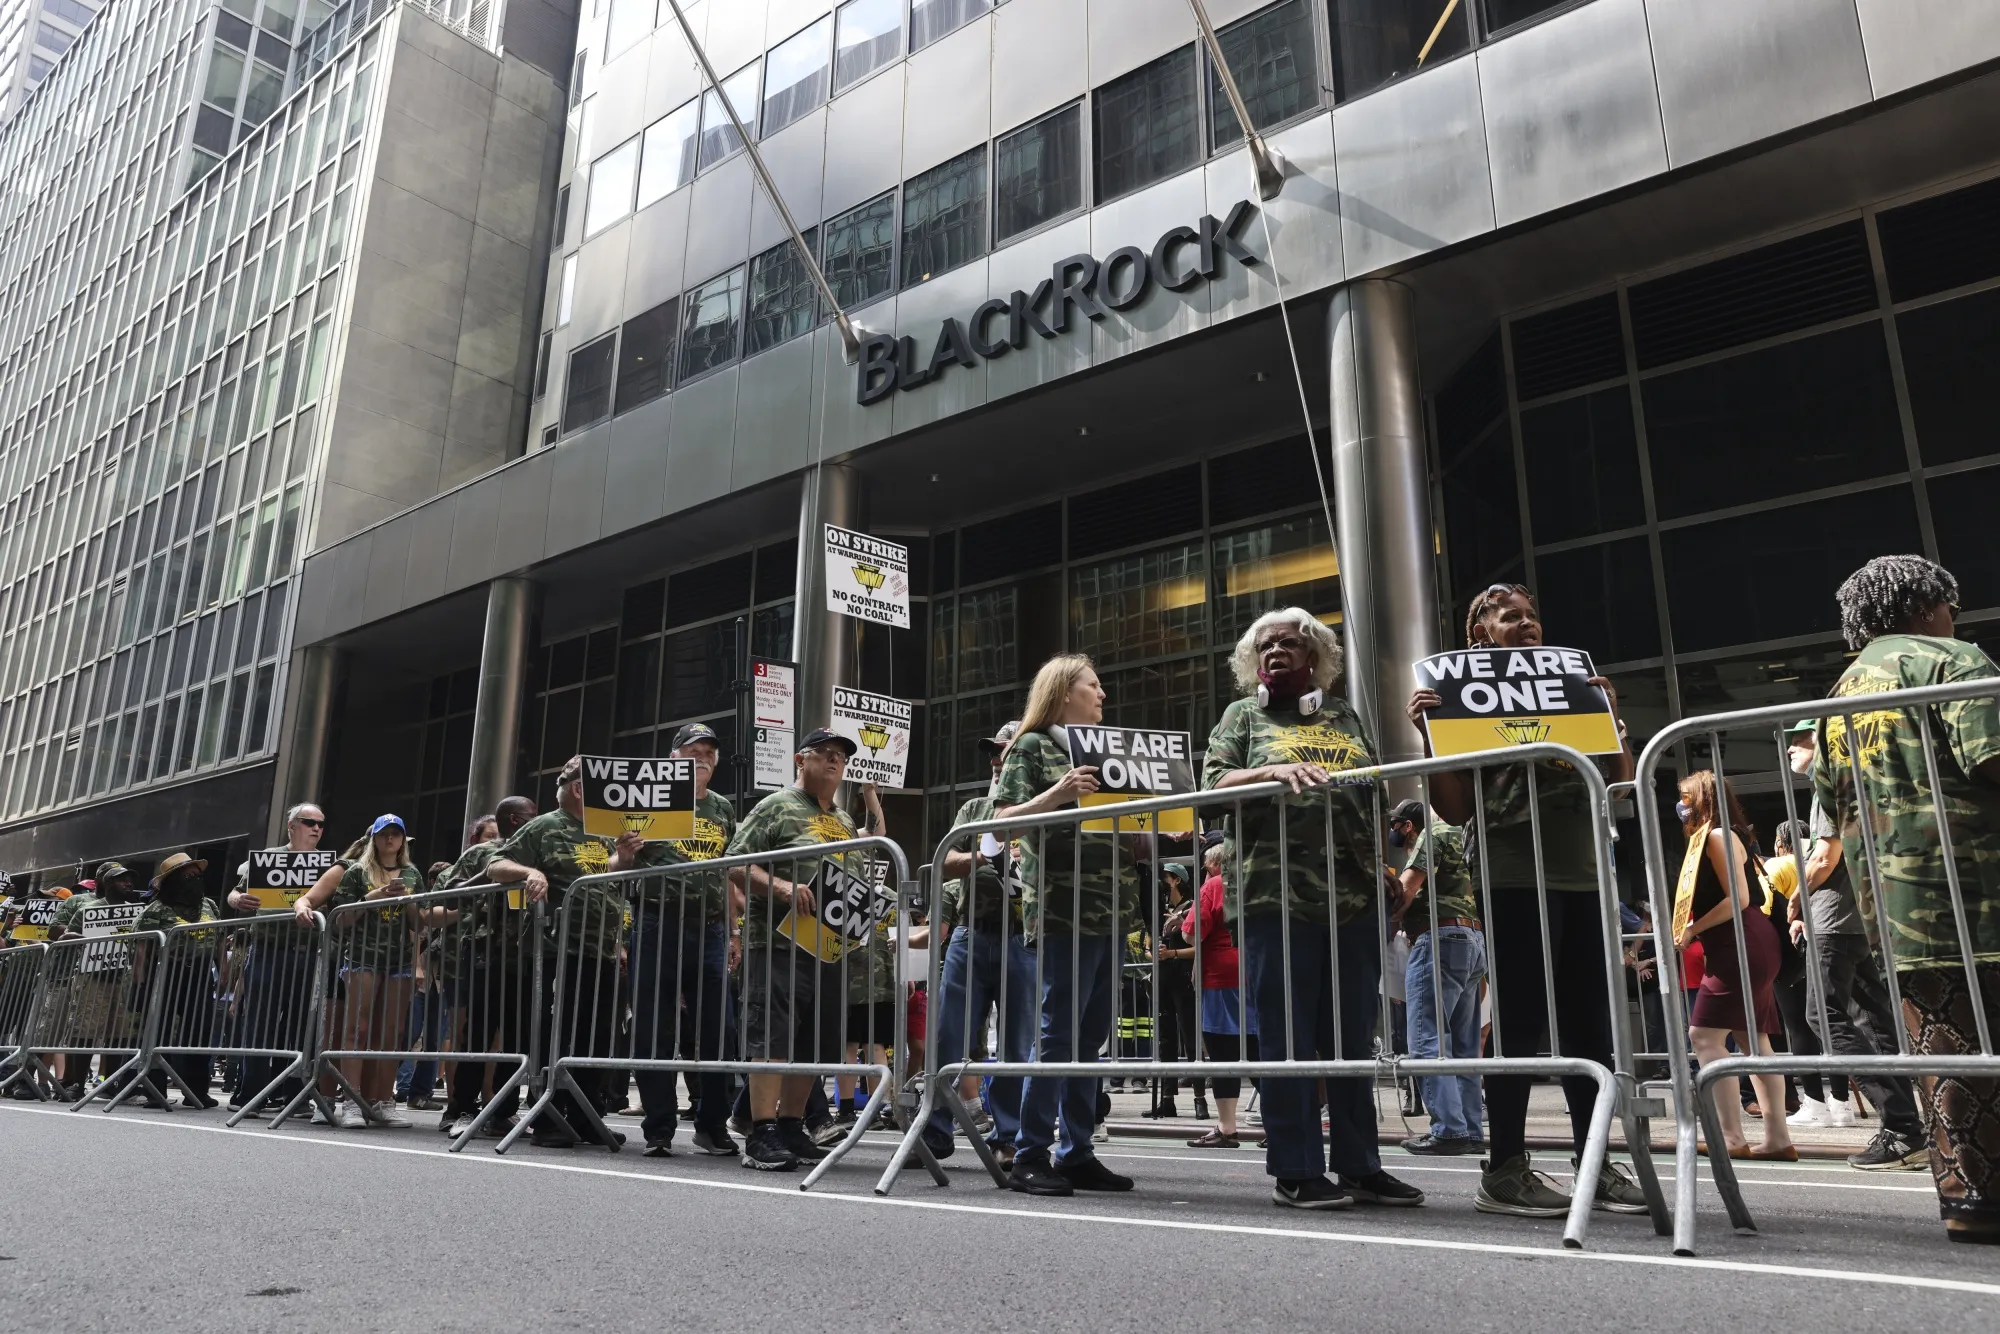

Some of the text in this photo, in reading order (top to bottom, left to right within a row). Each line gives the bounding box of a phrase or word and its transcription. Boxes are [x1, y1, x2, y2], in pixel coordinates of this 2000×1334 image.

[857, 199, 1262, 406] BLACKROCK
[827, 529, 906, 562] ON STRIKE
[827, 546, 836, 554] AT
[838, 549, 872, 563] WARRIOR
[873, 558, 888, 568] MET
[889, 563, 907, 574] COAL
[832, 589, 907, 618] NO CONTRACT,
[846, 603, 893, 623] NO COAL!
[757, 663, 765, 676] 3
[1422, 650, 1589, 681] WE ARE
[756, 679, 787, 690] COMMERCIAL
[756, 686, 792, 698] VEHICLES ONLY
[756, 695, 771, 703] Monday
[834, 690, 910, 719] ON STRIKE
[1460, 679, 1570, 713] ONE
[833, 709, 843, 717] AT
[844, 711, 880, 723] WARRIOR
[880, 717, 894, 726] MET
[894, 720, 910, 731] COAL
[756, 729, 765, 742] 6
[1074, 728, 1185, 760] WE ARE
[1326, 731, 1352, 741] ONE
[586, 758, 690, 781] WE ARE
[846, 768, 891, 784] NO COAL!
[852, 758, 903, 776] CONTRACT,
[1102, 758, 1172, 791] ONE
[603, 783, 672, 808] ONE
[254, 852, 332, 868] WE ARE
[266, 869, 319, 886] ONE
[825, 864, 868, 908] WE
[27, 900, 47, 911] WE
[85, 908, 110, 921] ON
[29, 911, 55, 924] ON
[95, 920, 133, 928] WARRIOR
